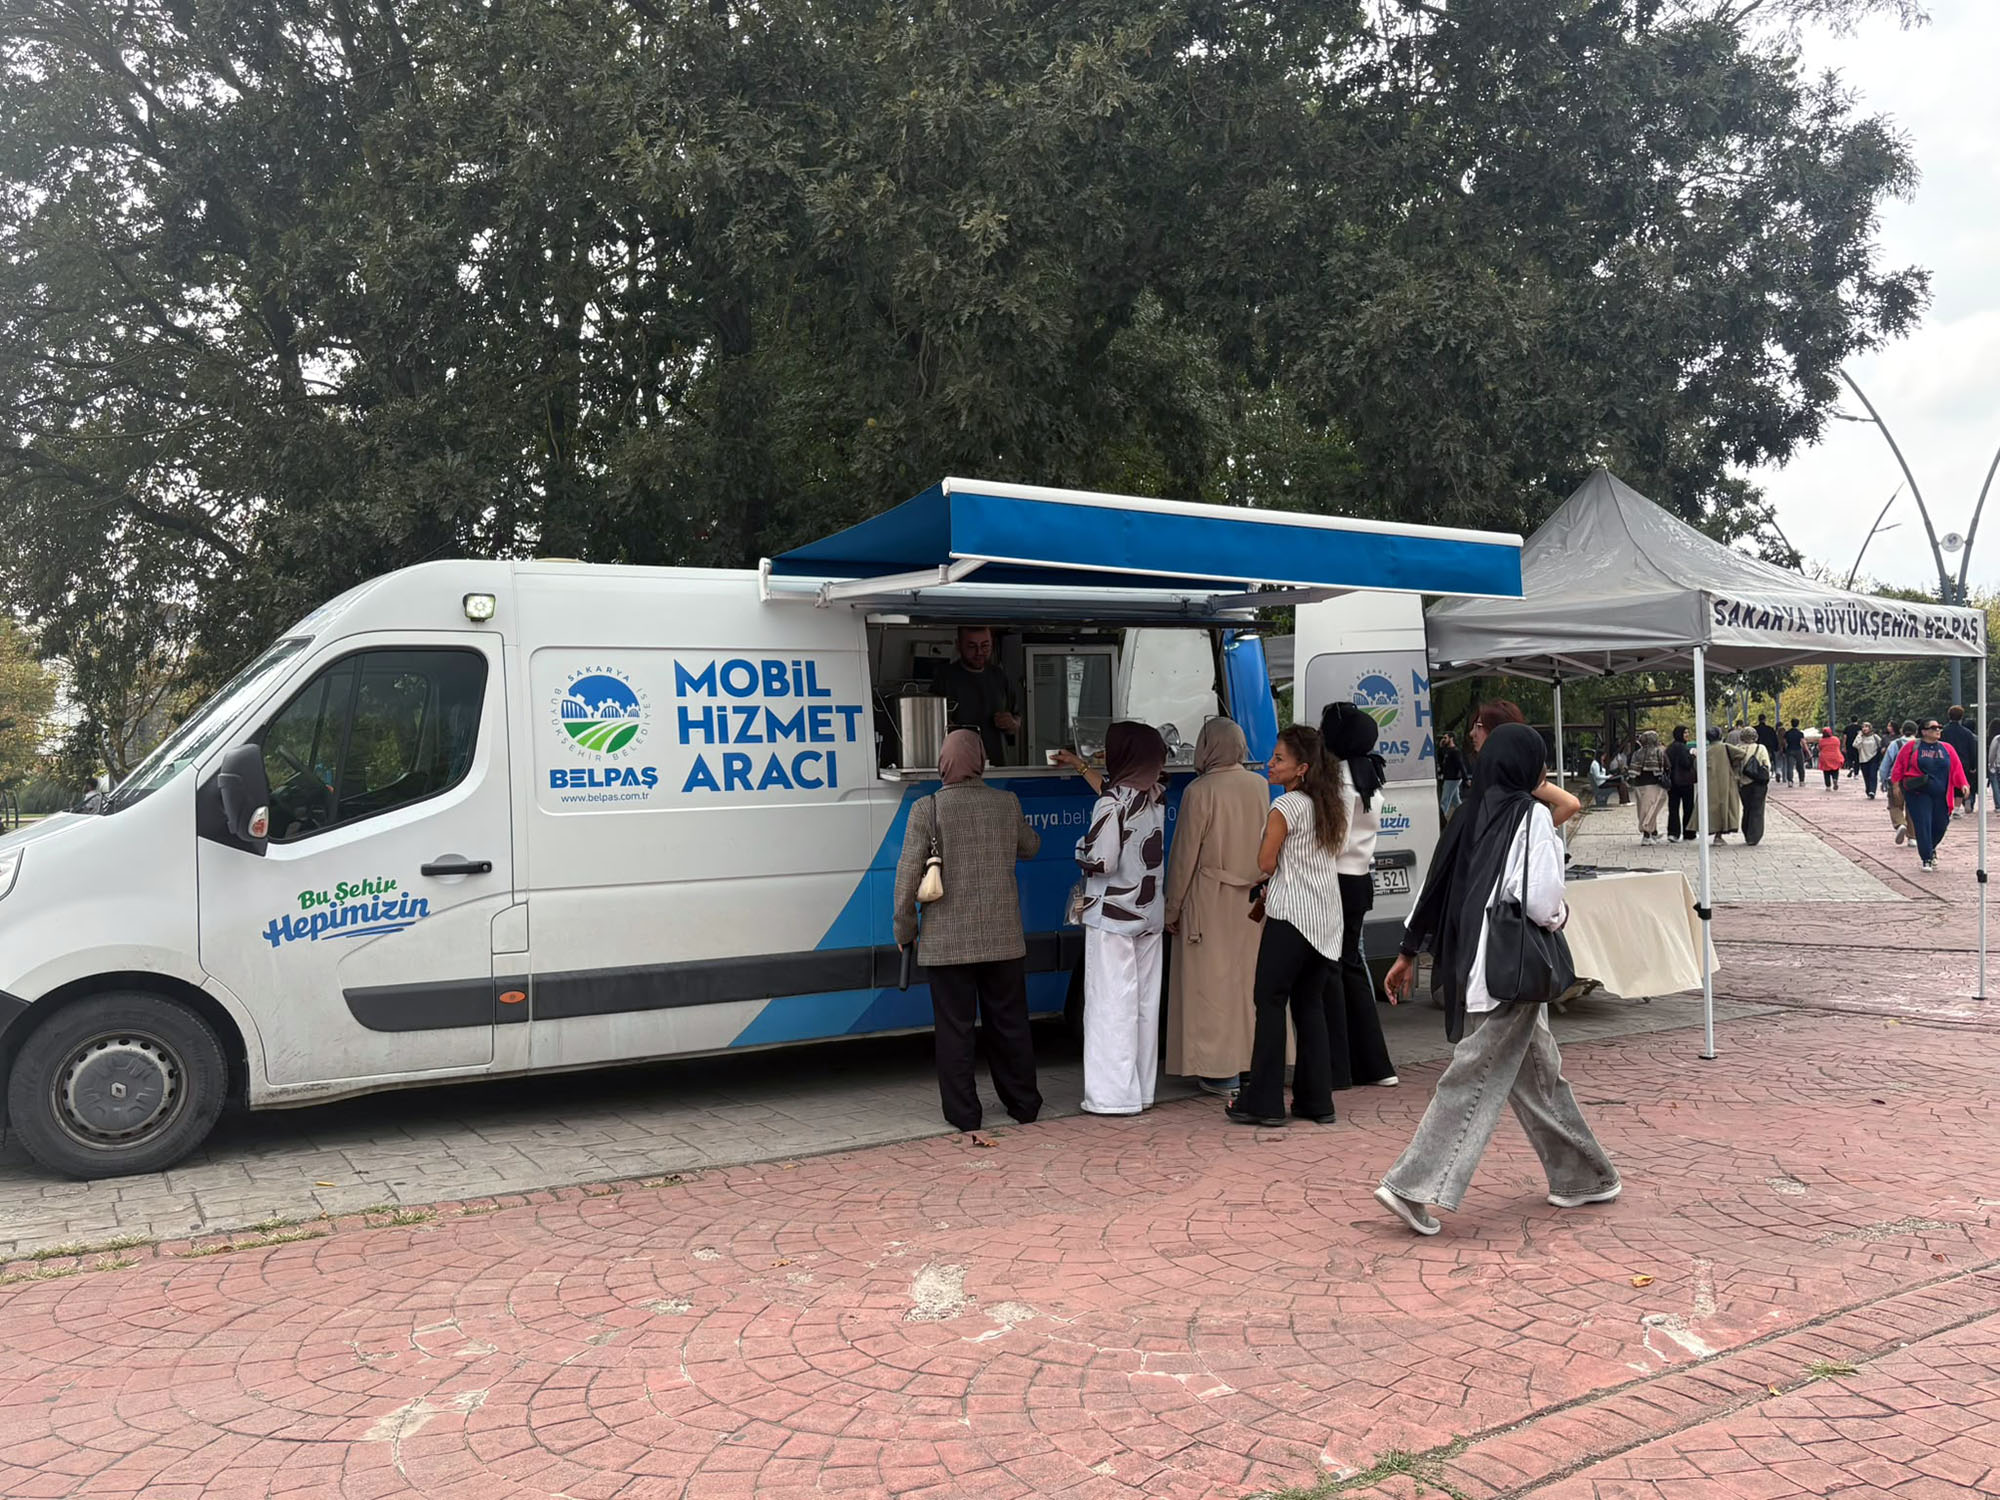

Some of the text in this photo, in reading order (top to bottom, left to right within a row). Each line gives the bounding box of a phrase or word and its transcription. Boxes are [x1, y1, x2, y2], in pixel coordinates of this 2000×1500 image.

[1714, 600, 1809, 633] SAKARYA
[1814, 602, 1918, 640] BÜYÜKŞEHİR
[568, 666, 630, 682] SAKARYA
[1373, 741, 1410, 756] PAŞ
[550, 767, 659, 789] BELPAŞ
[681, 750, 838, 792] ARACI
[298, 876, 398, 910] Bu Şehir
[263, 892, 430, 947] Hepimizin
